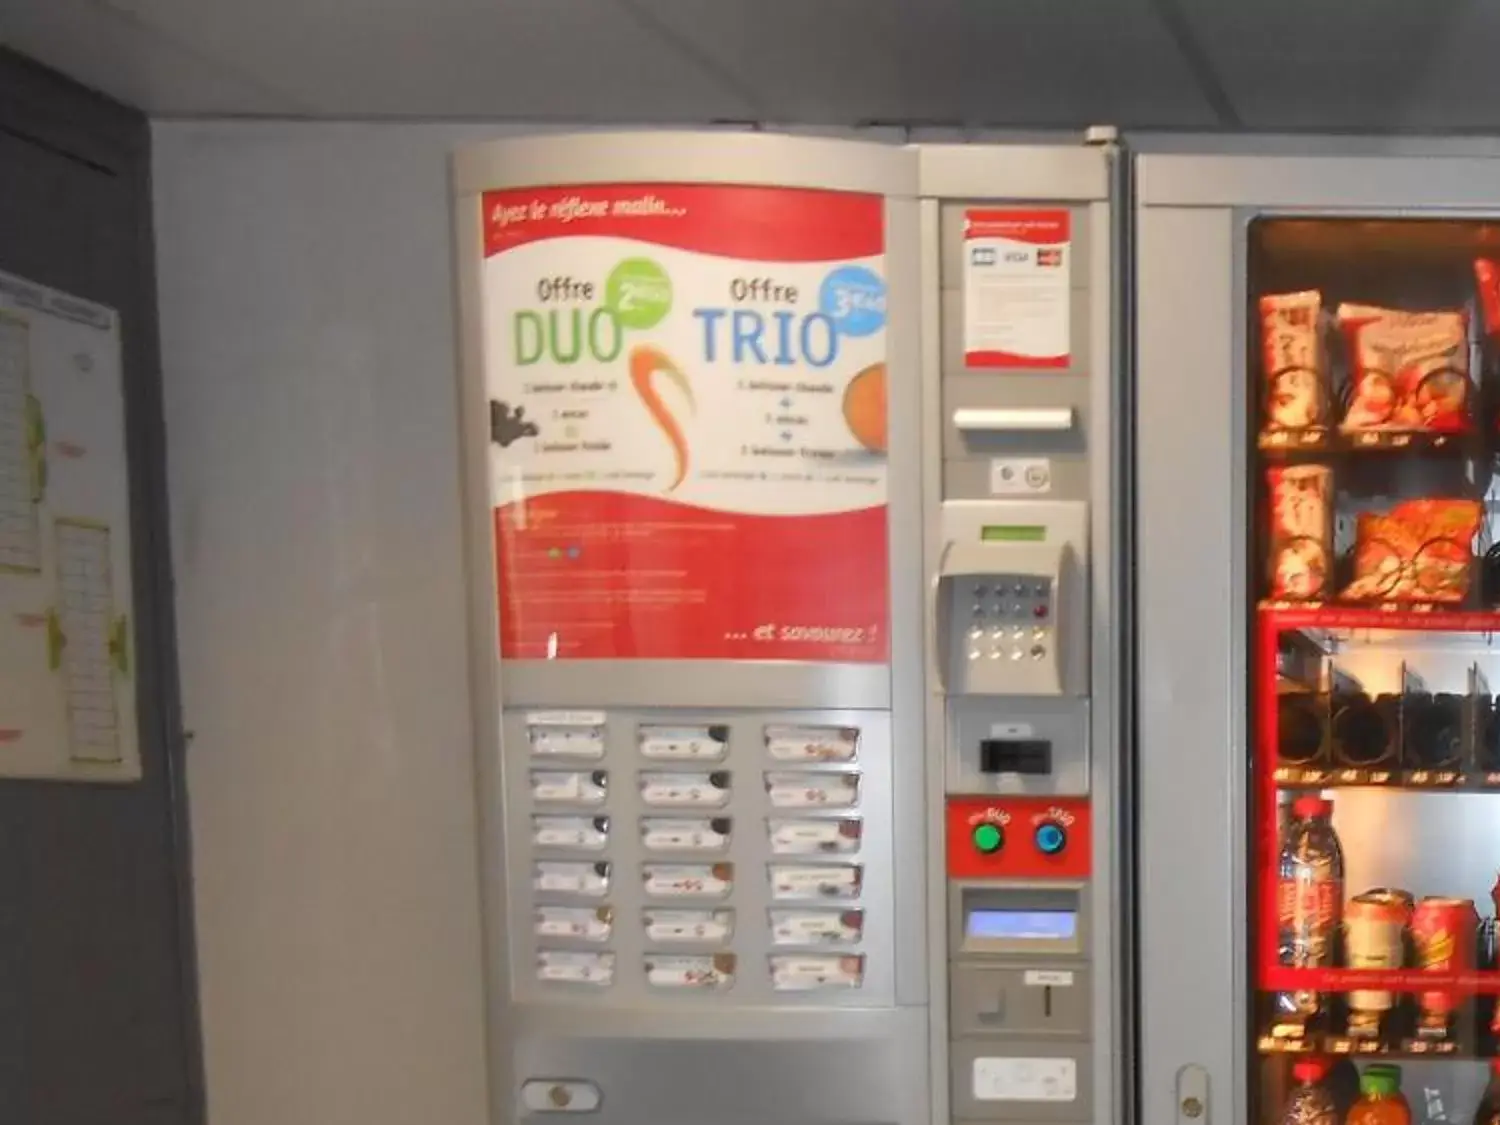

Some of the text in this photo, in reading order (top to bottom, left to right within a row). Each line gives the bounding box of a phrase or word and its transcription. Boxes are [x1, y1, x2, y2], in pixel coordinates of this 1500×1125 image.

[531, 199, 547, 221] le
[537, 276, 594, 302] Offre
[730, 277, 799, 304] Offre
[515, 307, 623, 367] DUO
[693, 308, 838, 367] TRIO
[753, 622, 775, 641] et
